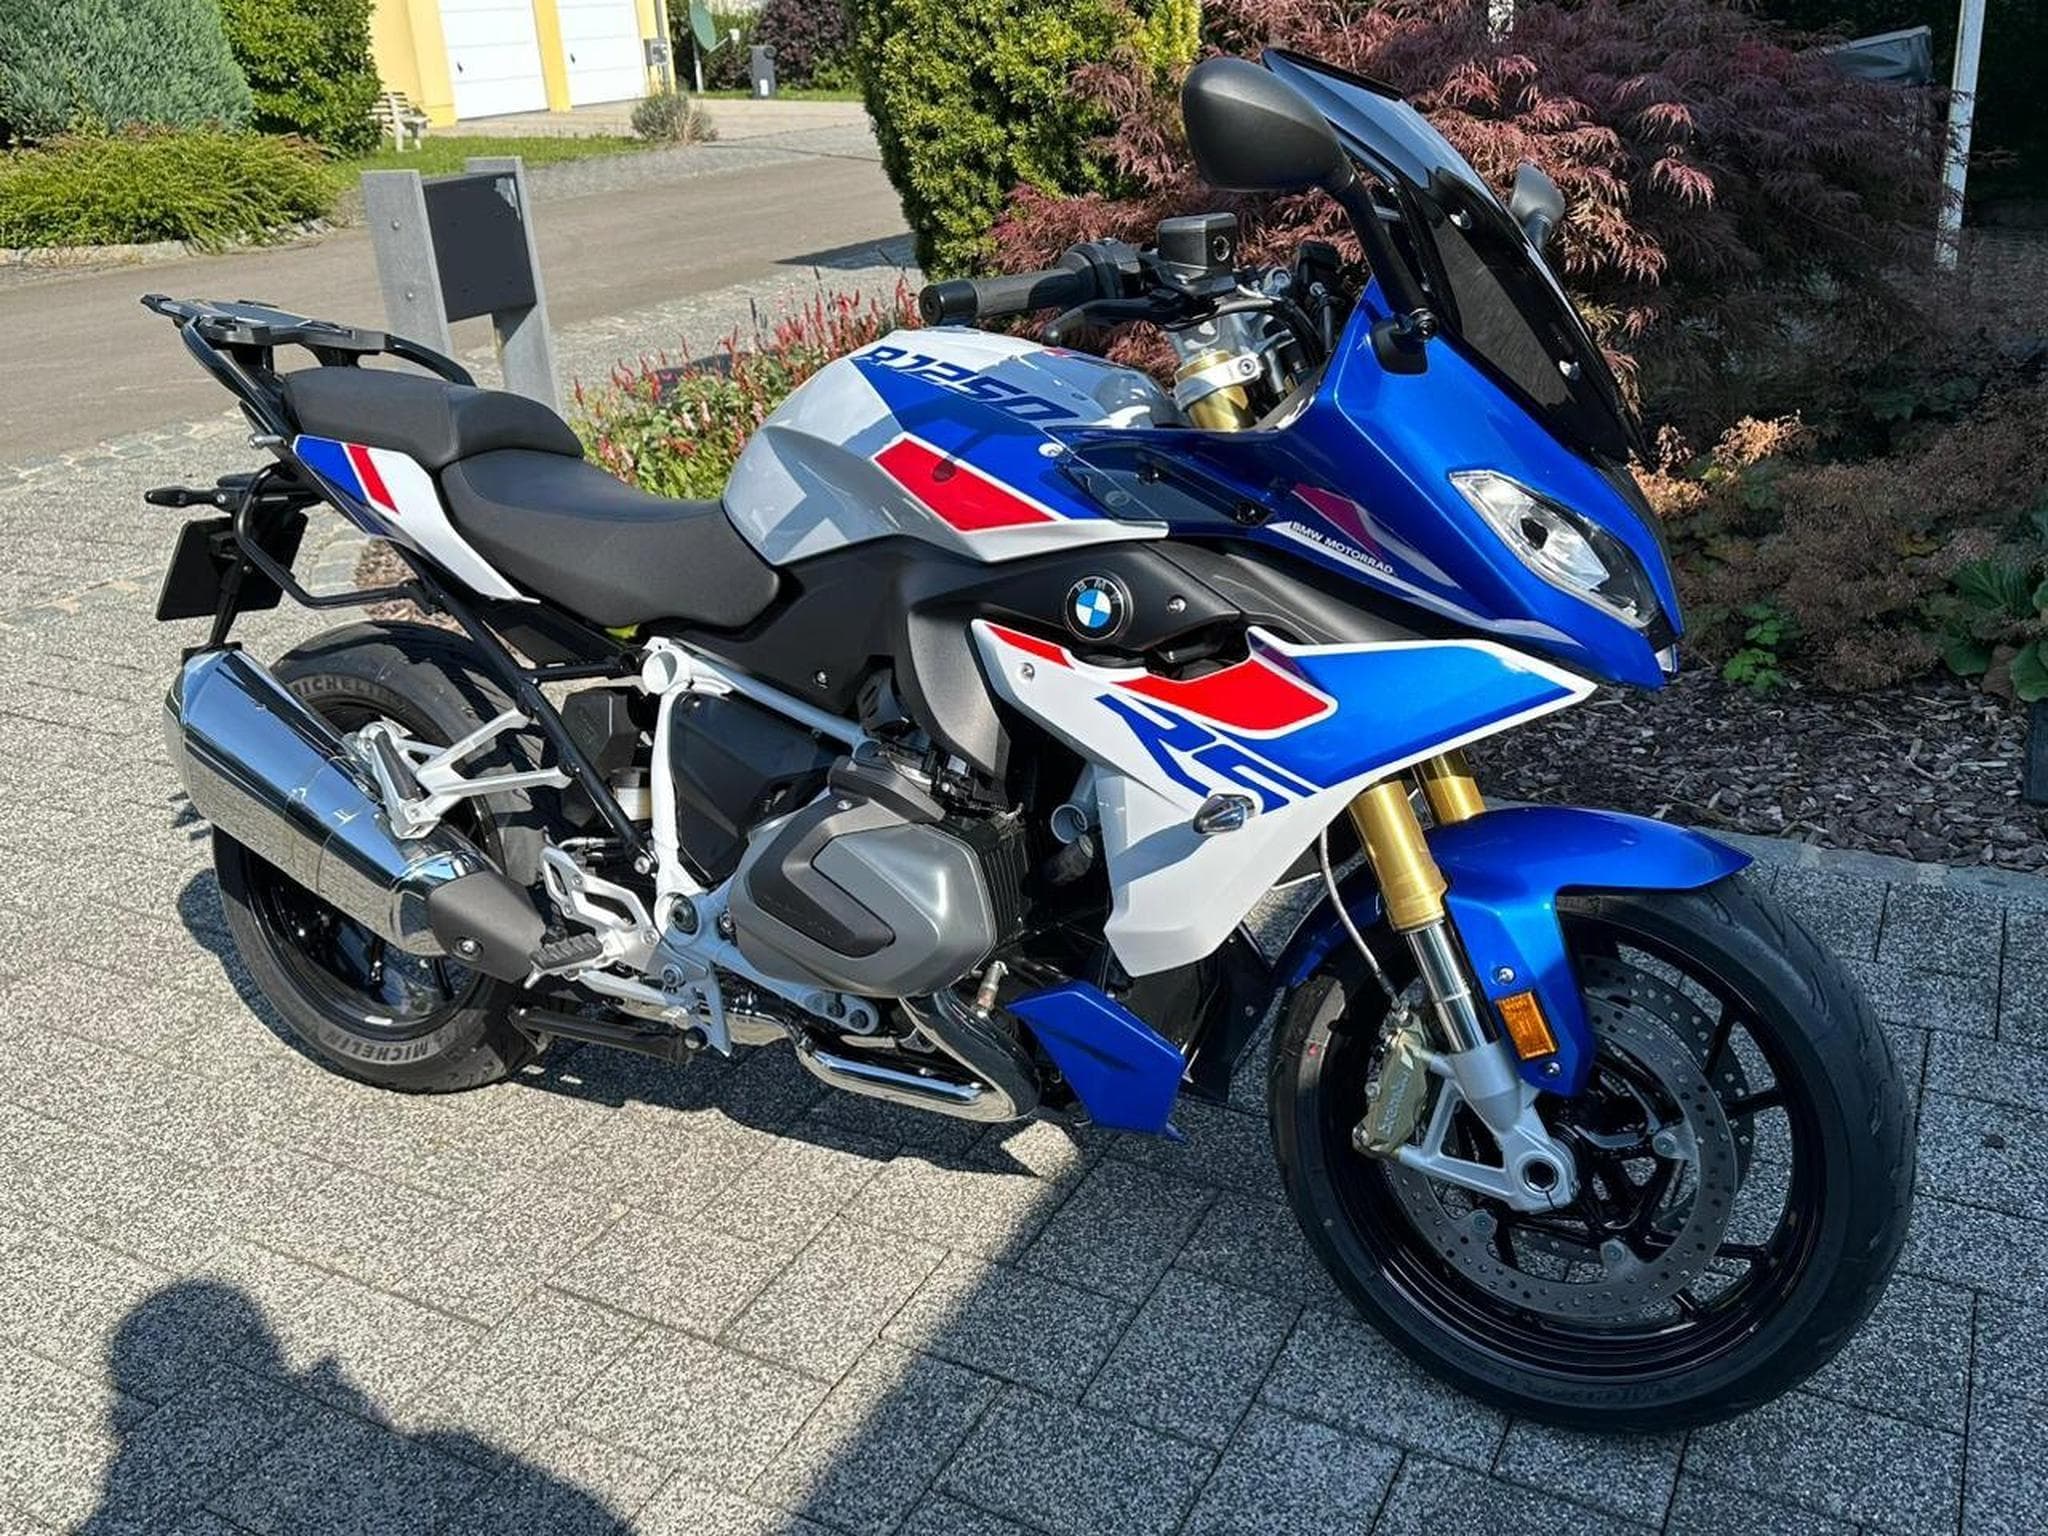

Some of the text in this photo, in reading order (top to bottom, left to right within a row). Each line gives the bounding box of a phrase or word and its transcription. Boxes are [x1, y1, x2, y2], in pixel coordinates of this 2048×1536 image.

[1291, 520, 1393, 575] BMW MOTORRAD
[1075, 577, 1121, 604] BMW
[1094, 693, 1319, 814] RS
[326, 1032, 428, 1062] MICHELIN
